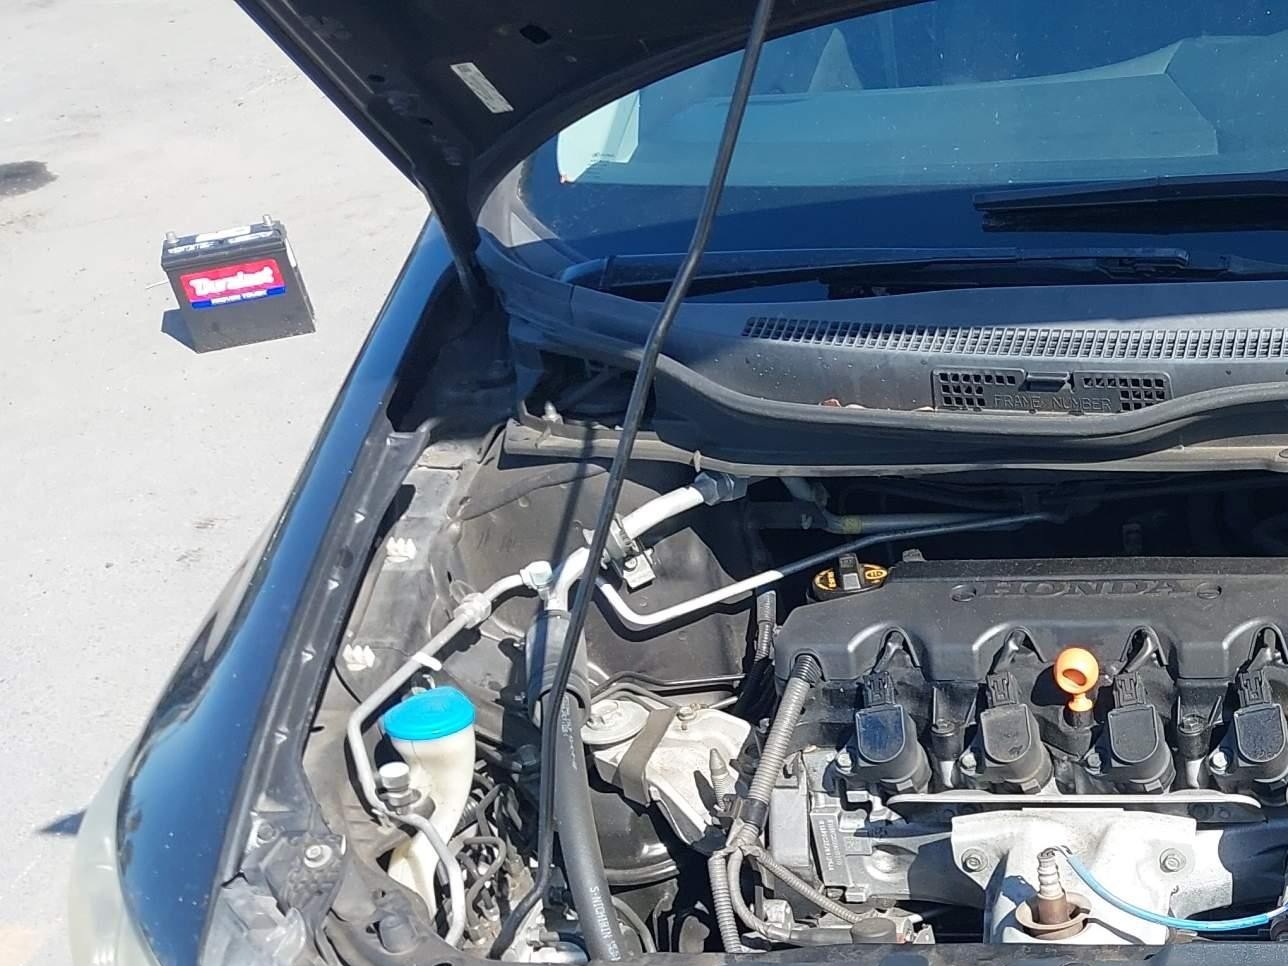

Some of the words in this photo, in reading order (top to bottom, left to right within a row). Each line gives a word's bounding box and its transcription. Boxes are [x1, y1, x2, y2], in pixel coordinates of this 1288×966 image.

[994, 394, 1041, 409] FRAME
[1052, 396, 1111, 411] NUMBER
[984, 579, 1189, 597] HONDA
